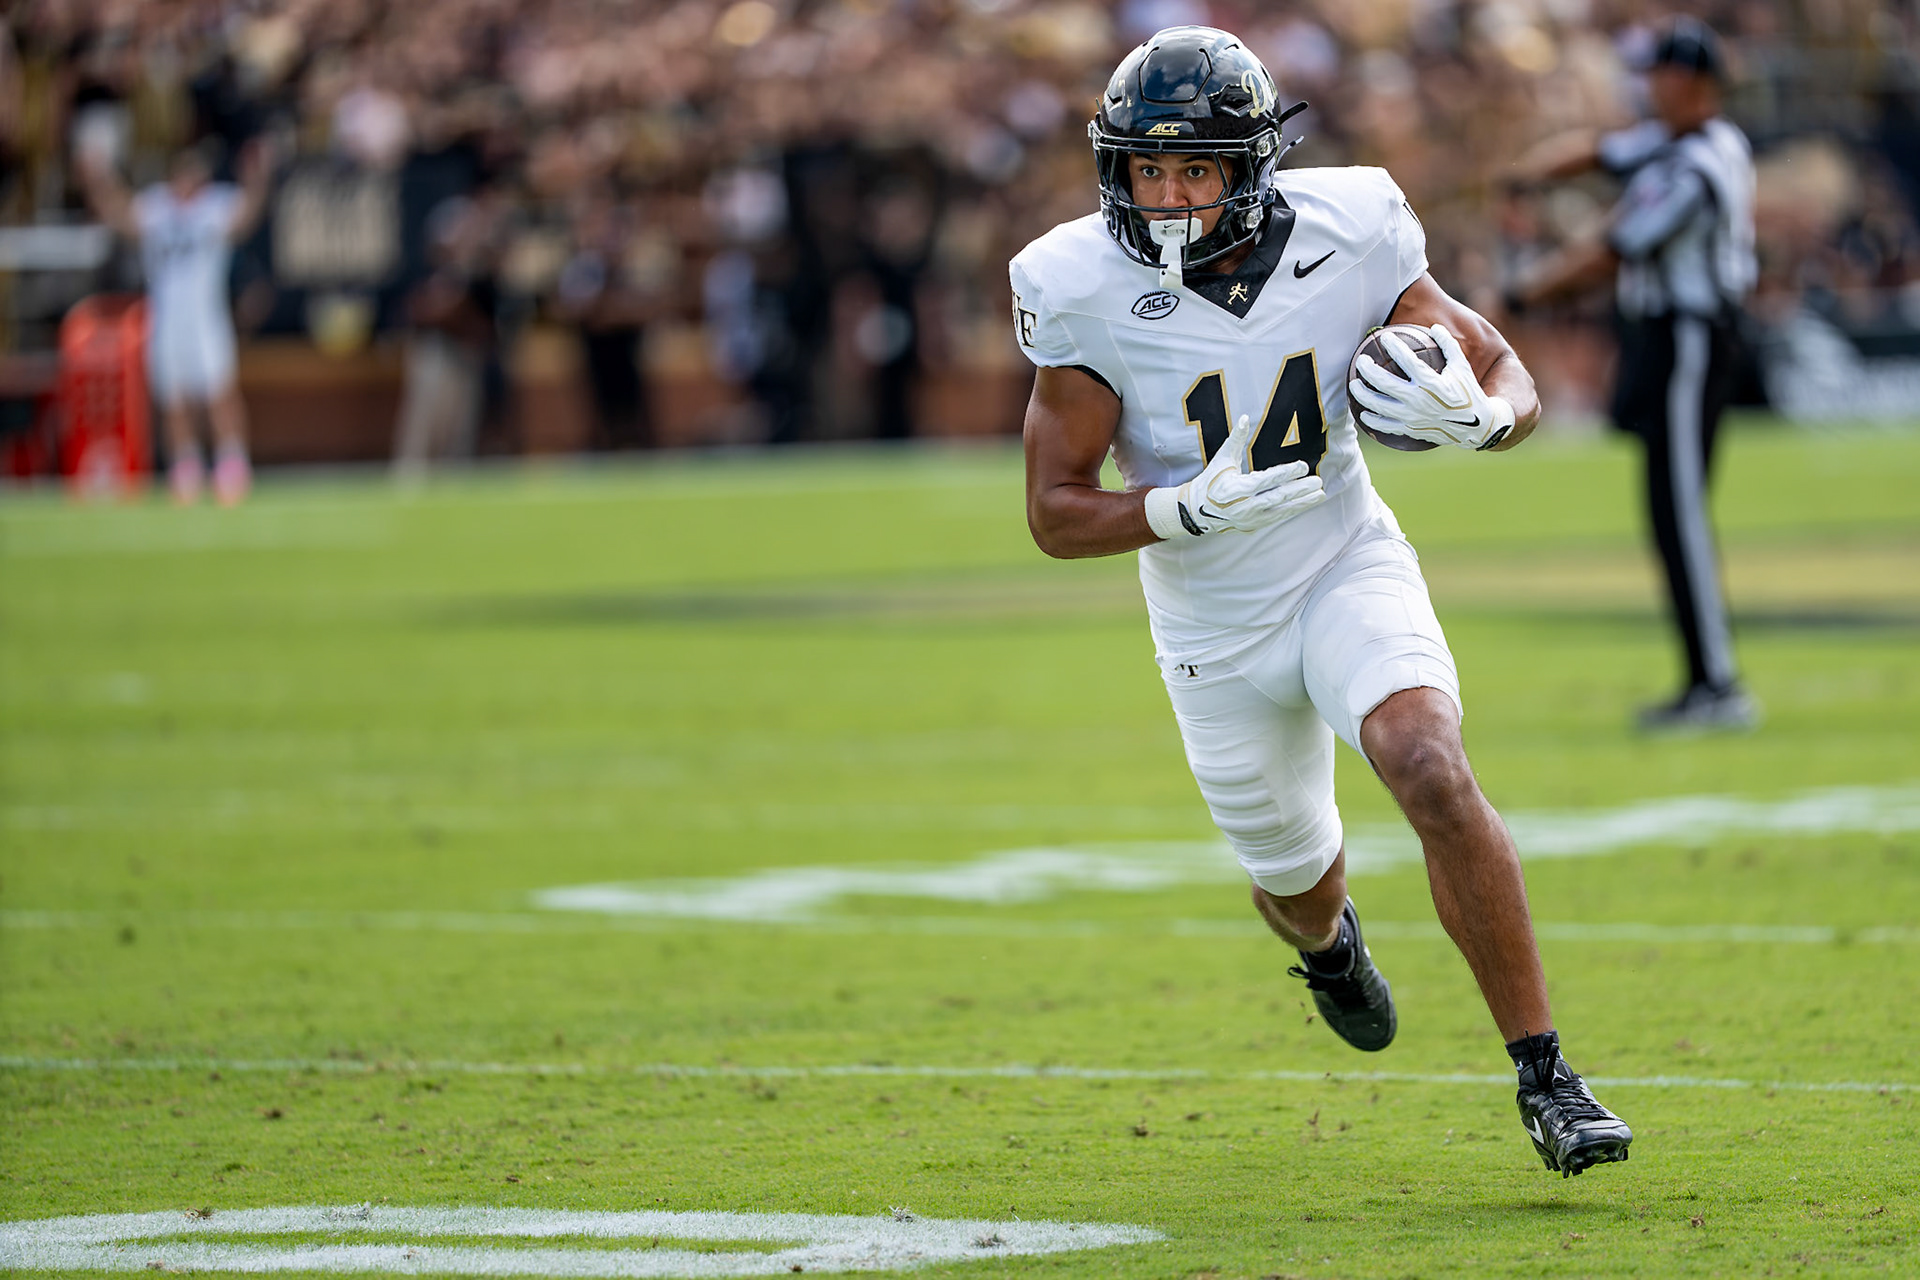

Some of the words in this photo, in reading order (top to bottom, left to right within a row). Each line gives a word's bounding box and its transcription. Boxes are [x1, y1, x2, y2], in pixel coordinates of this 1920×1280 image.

[1146, 123, 1182, 135] ACC
[1139, 295, 1172, 314] ACC
[1181, 347, 1329, 488] 14
